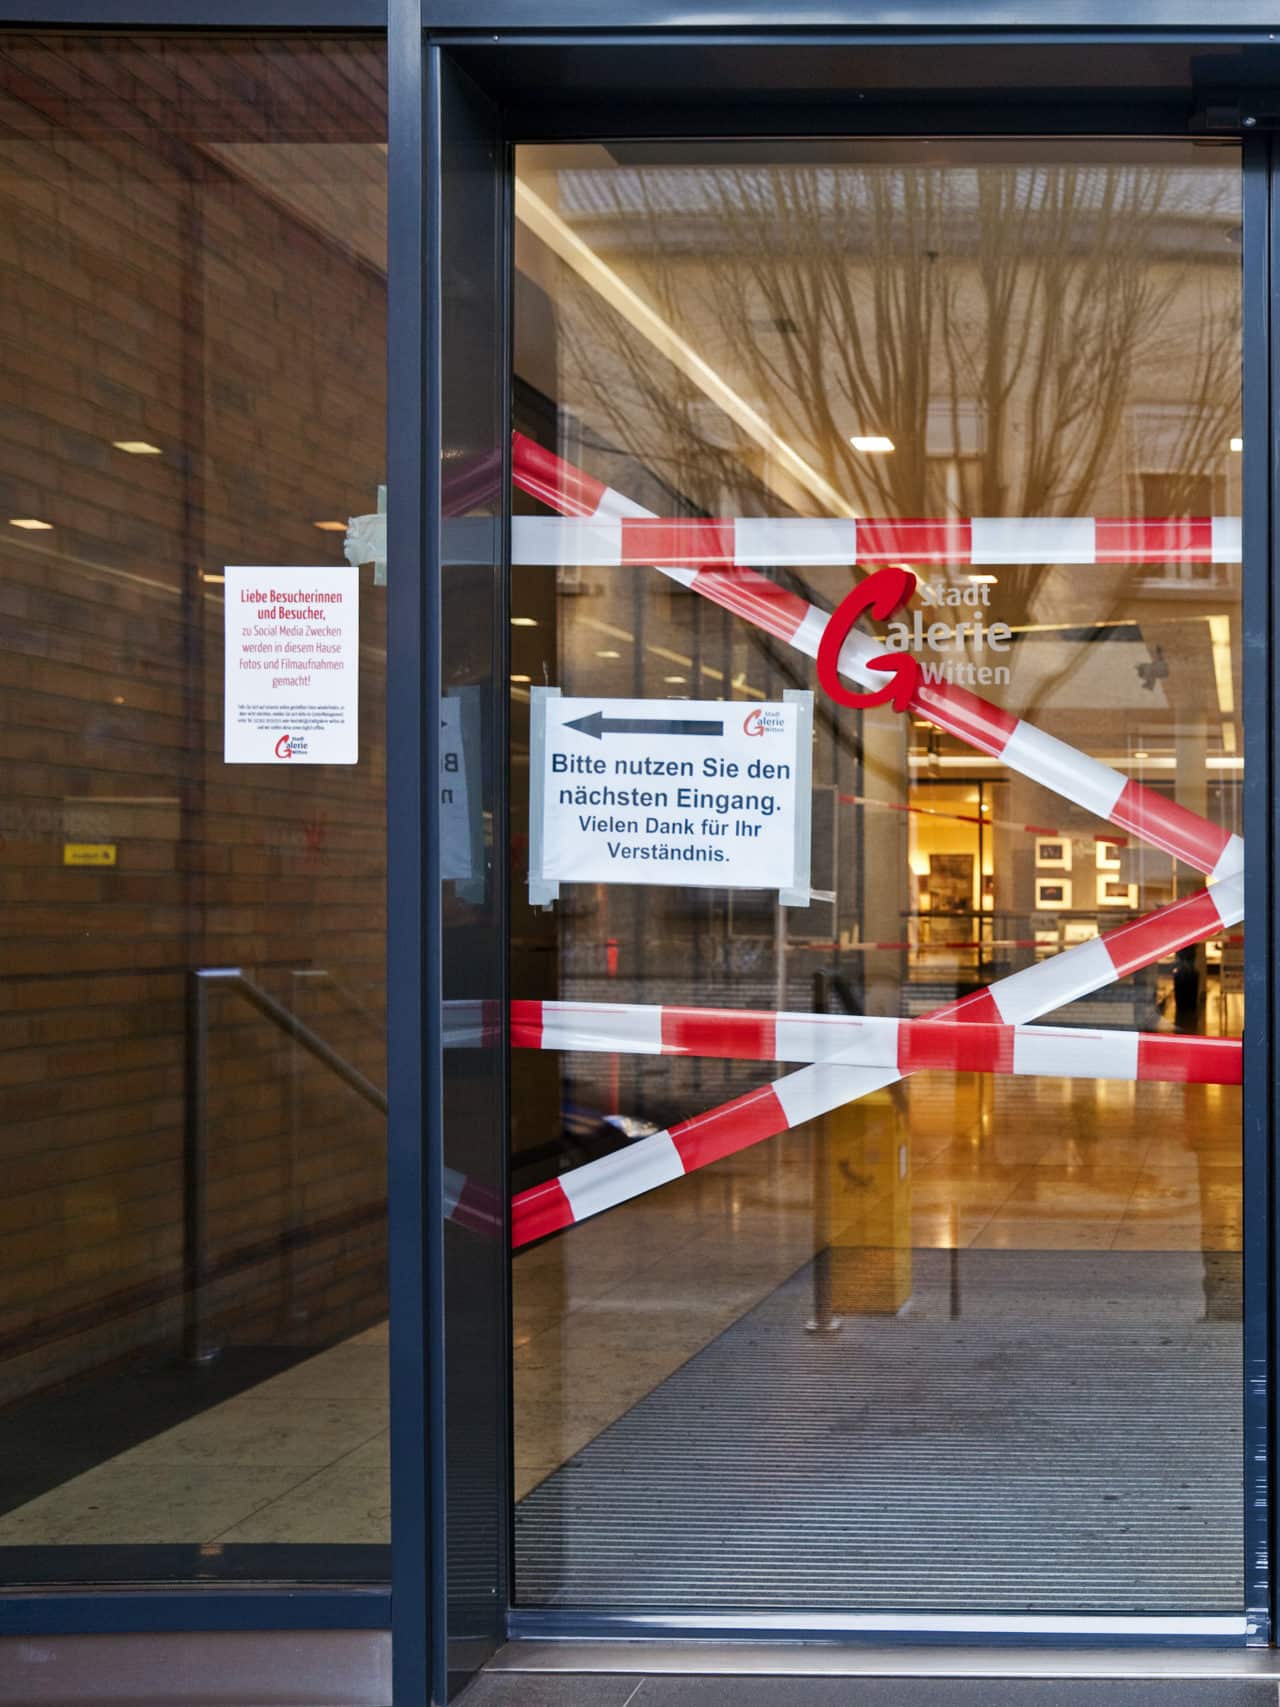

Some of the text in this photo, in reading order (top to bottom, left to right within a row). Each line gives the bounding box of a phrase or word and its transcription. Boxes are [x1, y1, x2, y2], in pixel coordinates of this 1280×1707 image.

[241, 589, 343, 603] Liebe Besucherinnen
[921, 582, 991, 607] Stadt
[257, 606, 326, 620] und Besucher,
[242, 625, 342, 637] zu Social Media Zwecken
[816, 567, 1012, 713] Galerie
[242, 642, 342, 653] werden in diesem Hause
[240, 658, 344, 670] Fotos und Filmaufnahmen
[921, 661, 1010, 684] Witten
[272, 675, 311, 688] gemacht!
[552, 753, 790, 780] Bitte nutzen Sie den
[559, 785, 781, 815] nächsten Eingang.
[578, 815, 762, 837] Vielen Dank für Ihr
[607, 842, 730, 862] Verständnis.
